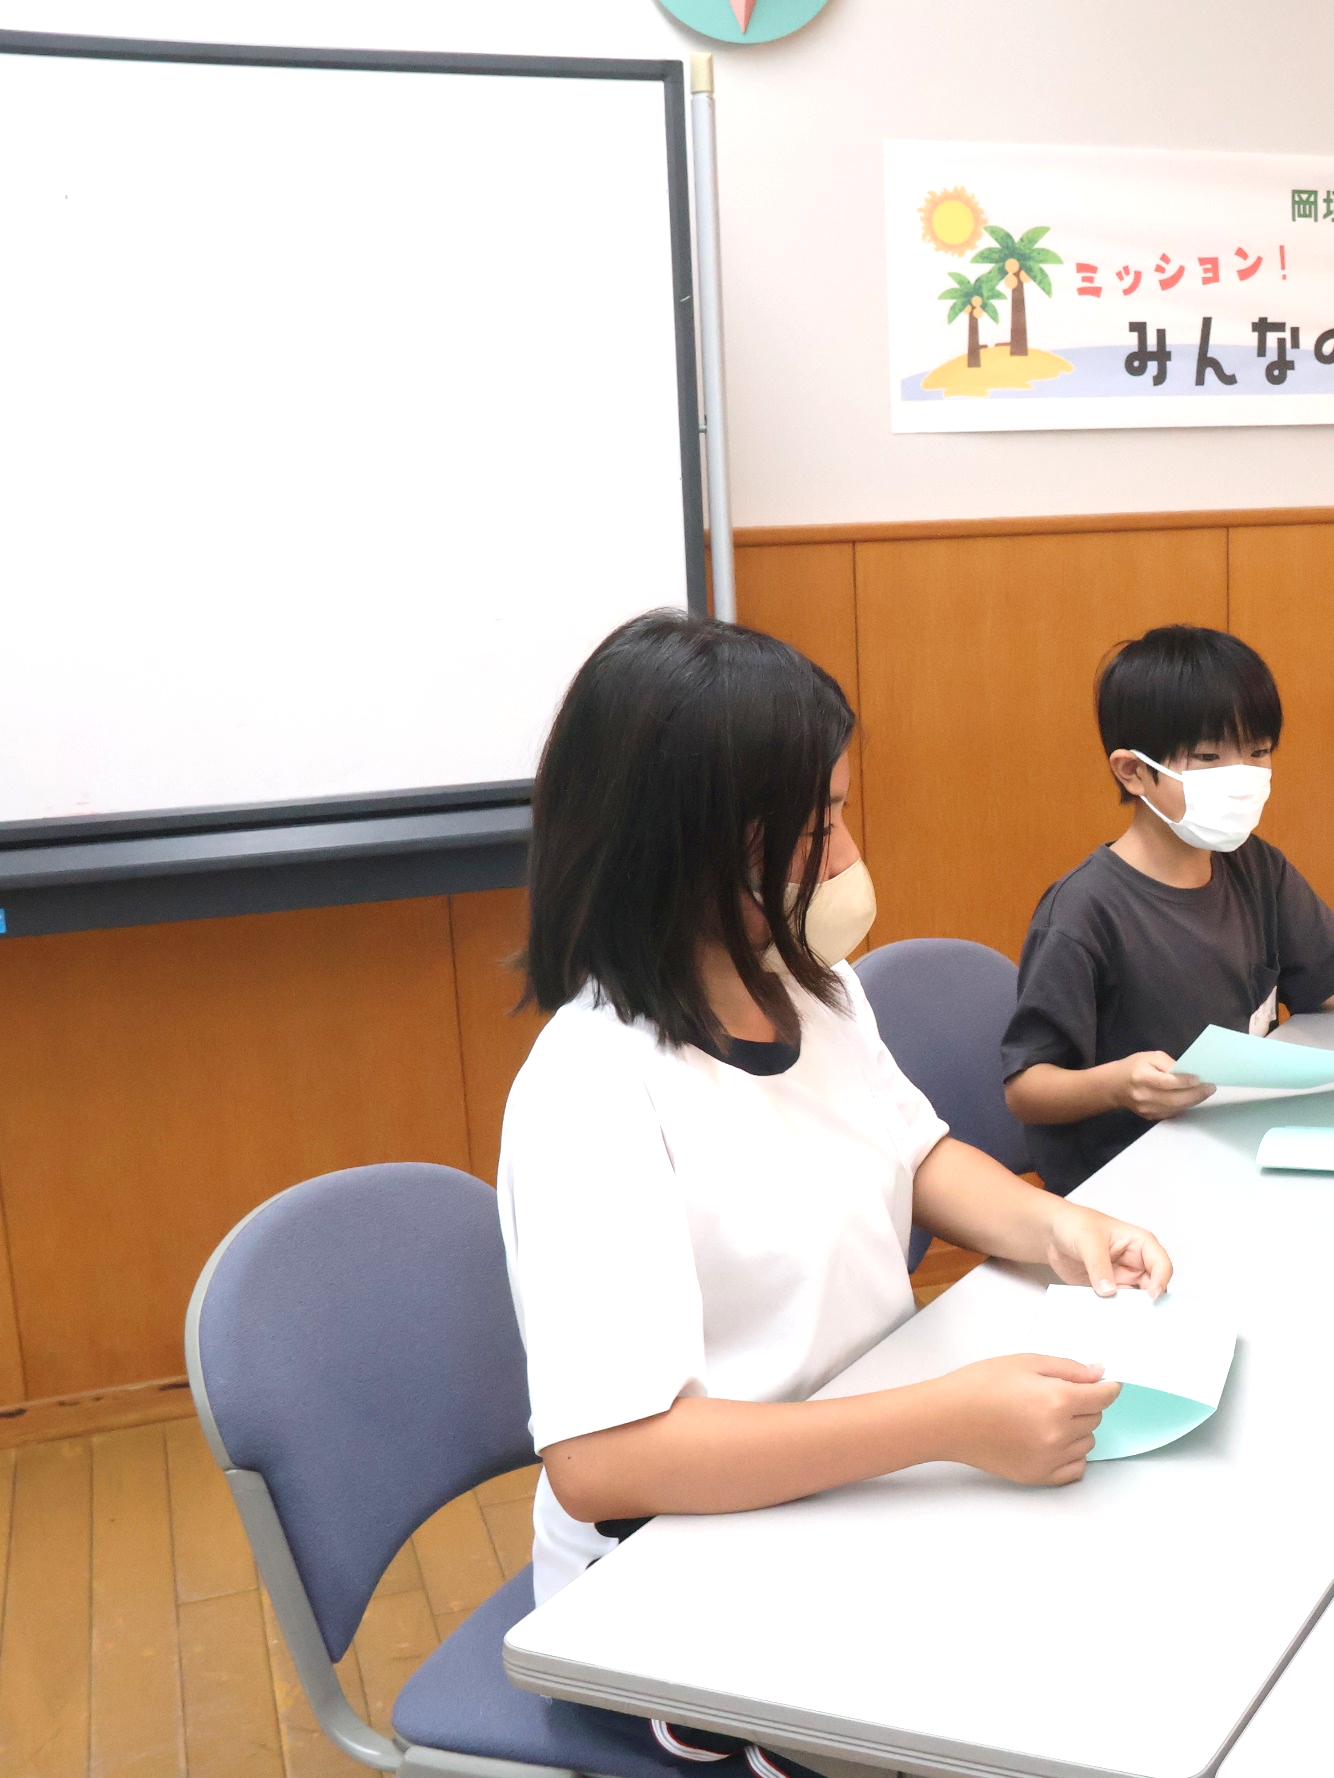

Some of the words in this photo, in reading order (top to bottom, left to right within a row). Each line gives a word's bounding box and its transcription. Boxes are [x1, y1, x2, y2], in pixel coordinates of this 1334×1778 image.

[1074, 244, 1290, 298] ミッション！
